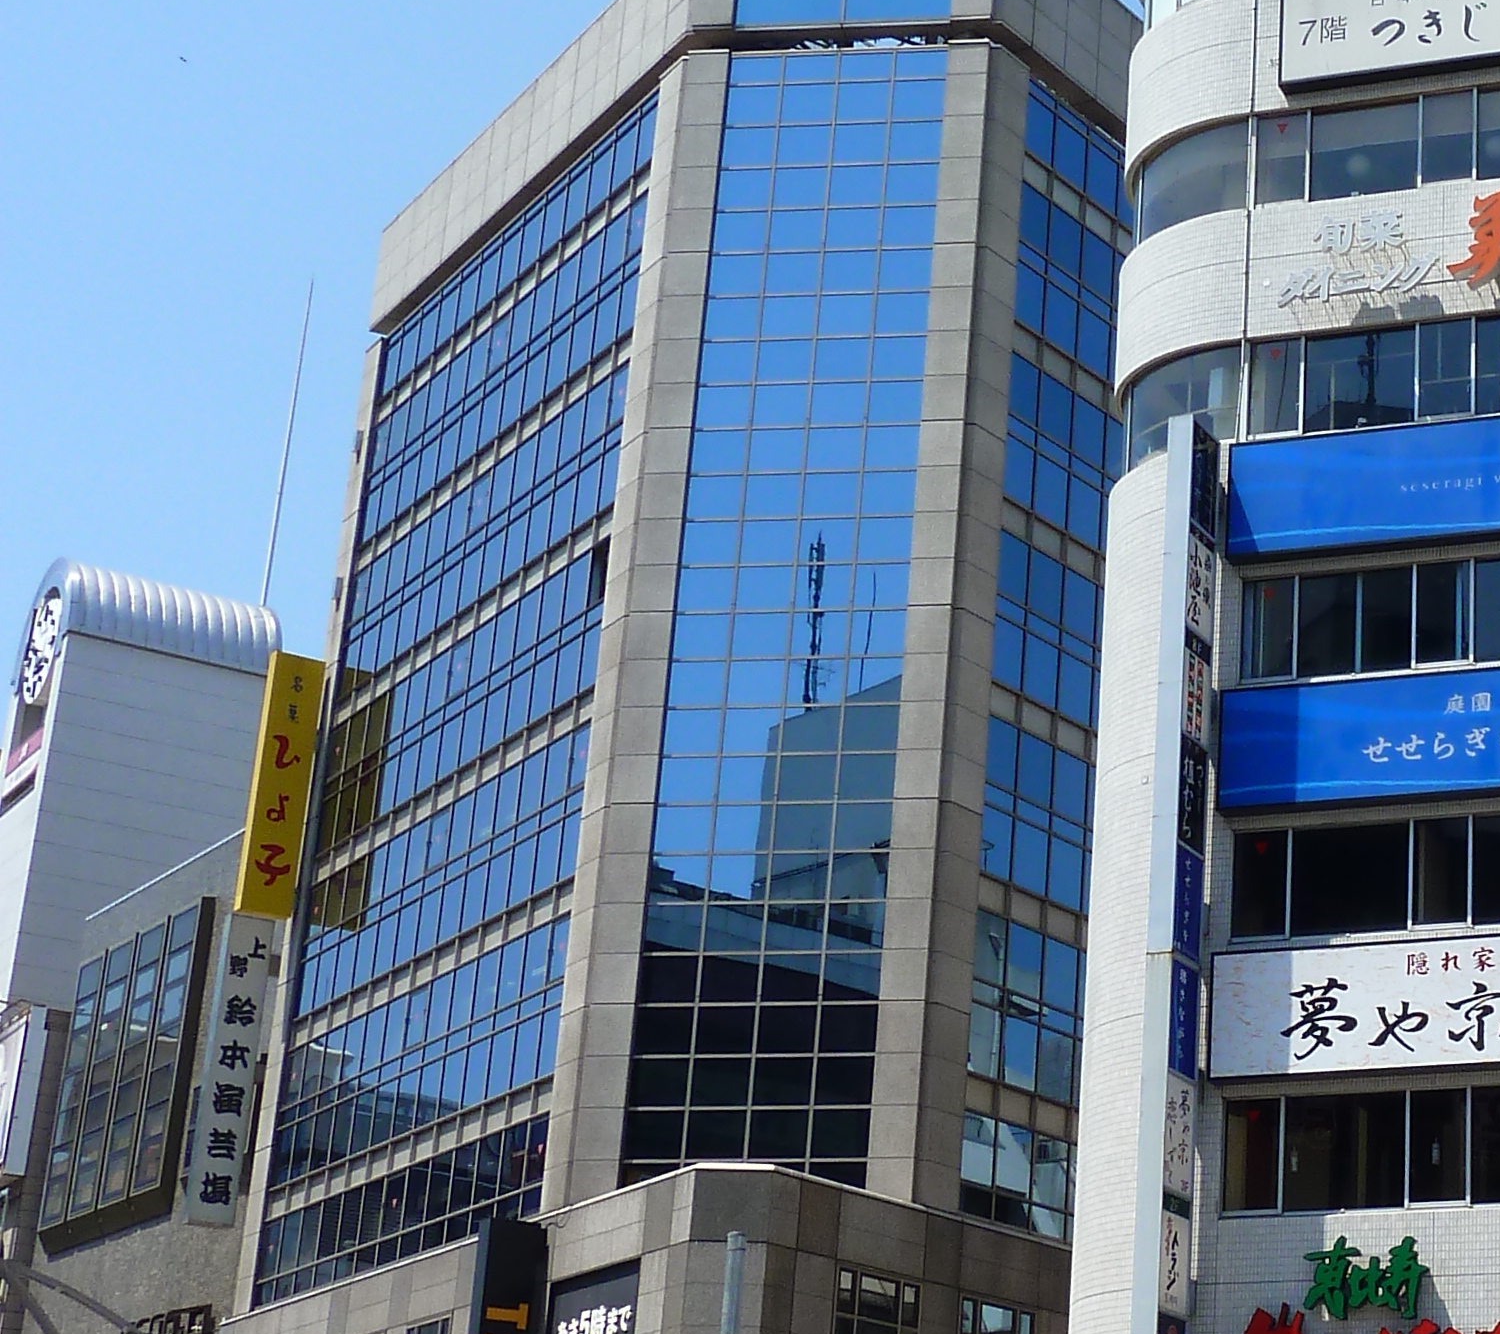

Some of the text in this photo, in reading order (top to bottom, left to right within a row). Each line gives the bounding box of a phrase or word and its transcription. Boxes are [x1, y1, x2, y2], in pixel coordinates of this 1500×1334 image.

[1298, 14, 1349, 47] 7階
[1371, 1, 1488, 47] つきじ
[1312, 208, 1405, 254] 旬菜
[1276, 250, 1441, 309] ダイニング
[1399, 472, 1485, 493] seseragi
[1443, 691, 1492, 717] 庭園
[254, 733, 302, 887] ひよ子
[228, 935, 268, 981] 上野
[1302, 1235, 1430, 1322] 恵比寿
